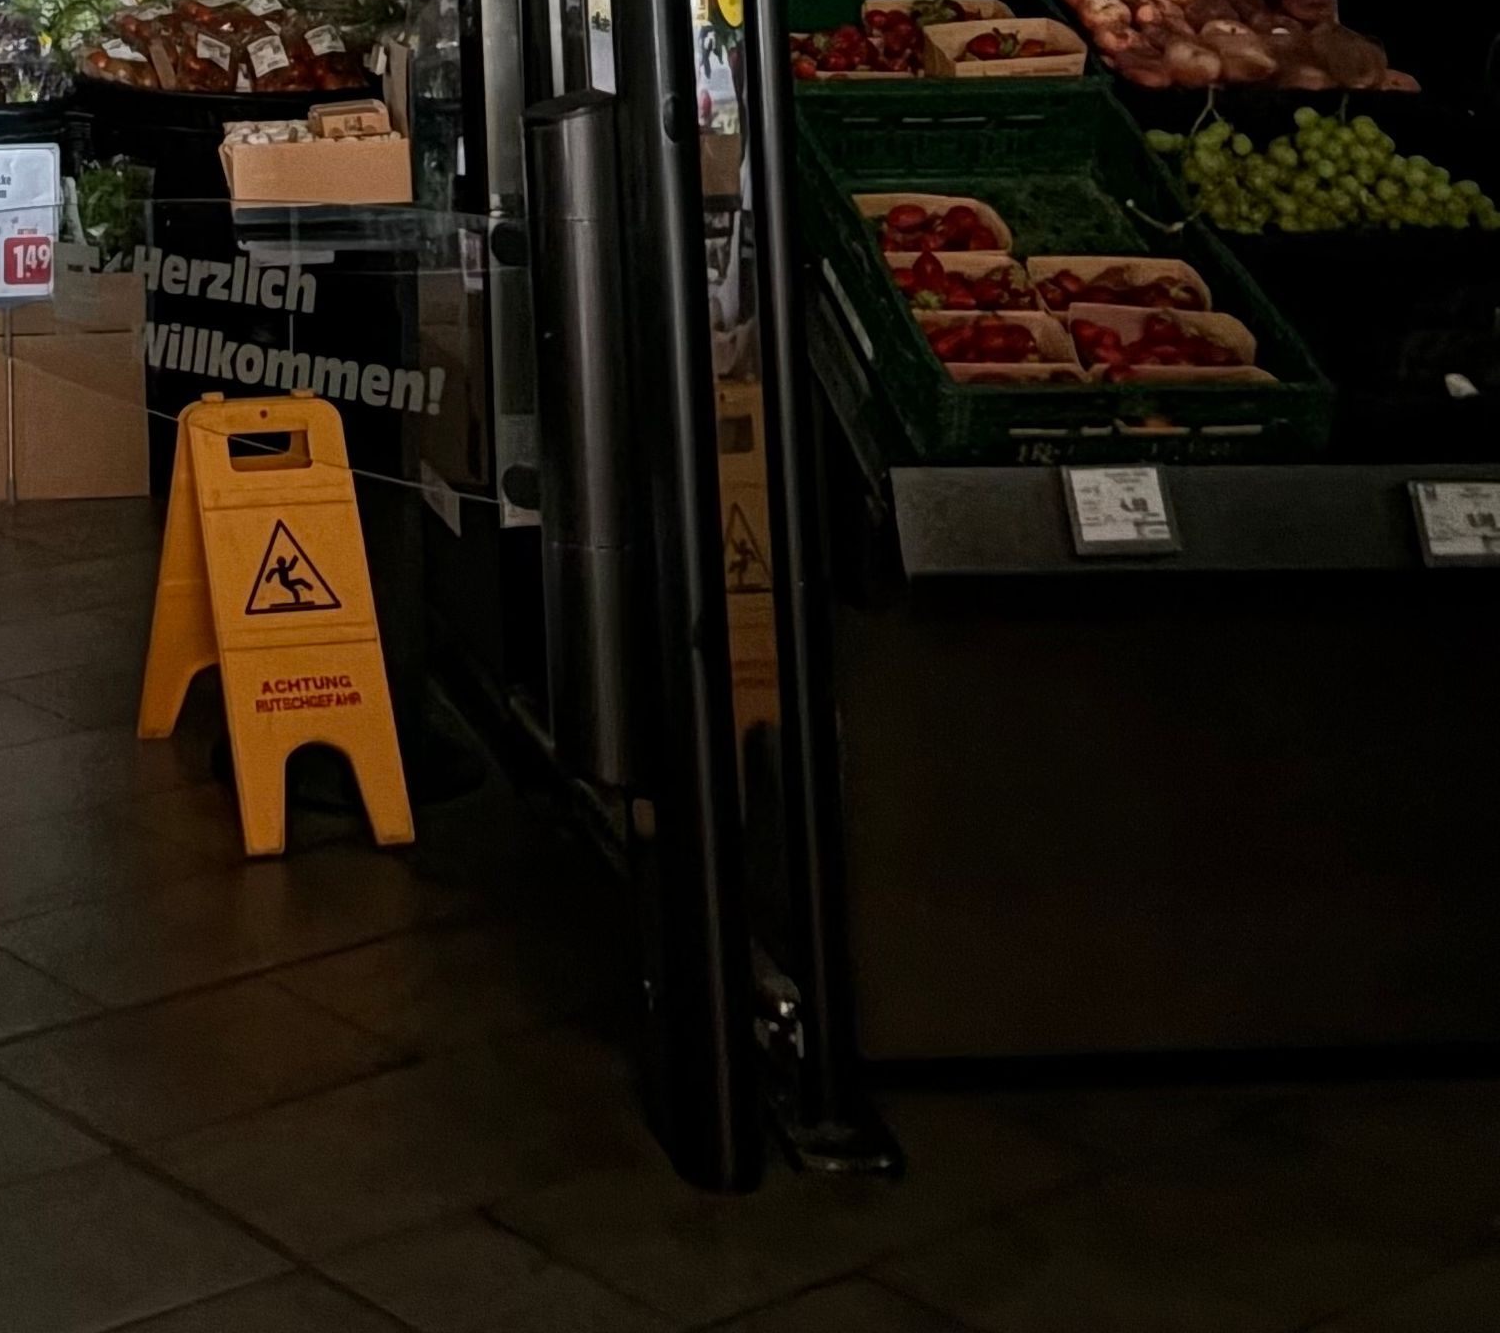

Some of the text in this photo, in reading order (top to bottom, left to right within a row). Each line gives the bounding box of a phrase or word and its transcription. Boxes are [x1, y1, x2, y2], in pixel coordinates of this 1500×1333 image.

[132, 244, 317, 314] Herzlich
[261, 675, 352, 695] ACHTUNG
[255, 691, 362, 713] RUTSCHGEFAHR
